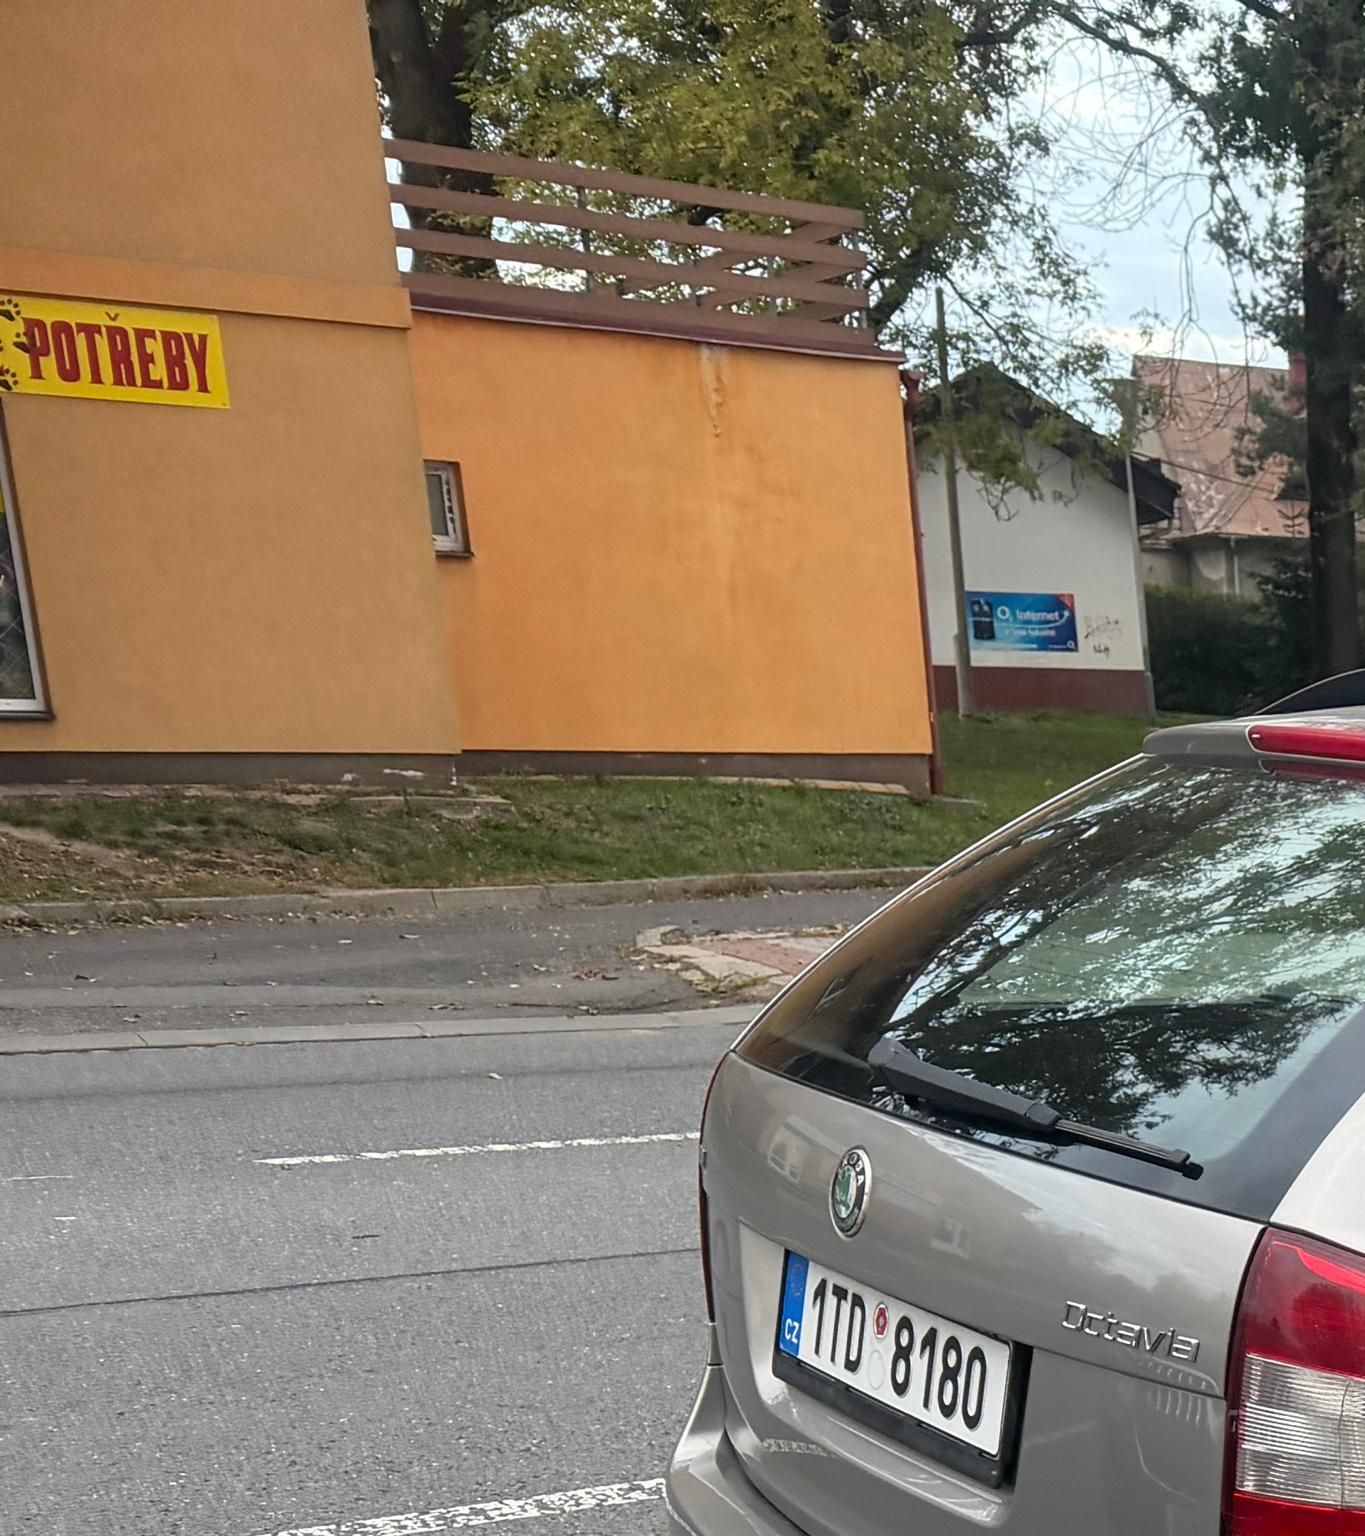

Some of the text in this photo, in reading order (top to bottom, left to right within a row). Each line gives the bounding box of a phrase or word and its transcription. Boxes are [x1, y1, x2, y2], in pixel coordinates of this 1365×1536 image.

[20, 311, 212, 395] POTŘEBY
[784, 1317, 799, 1344] CZ
[811, 1277, 988, 1431] 1TD 8180
[1061, 1300, 1200, 1363] Octavia
